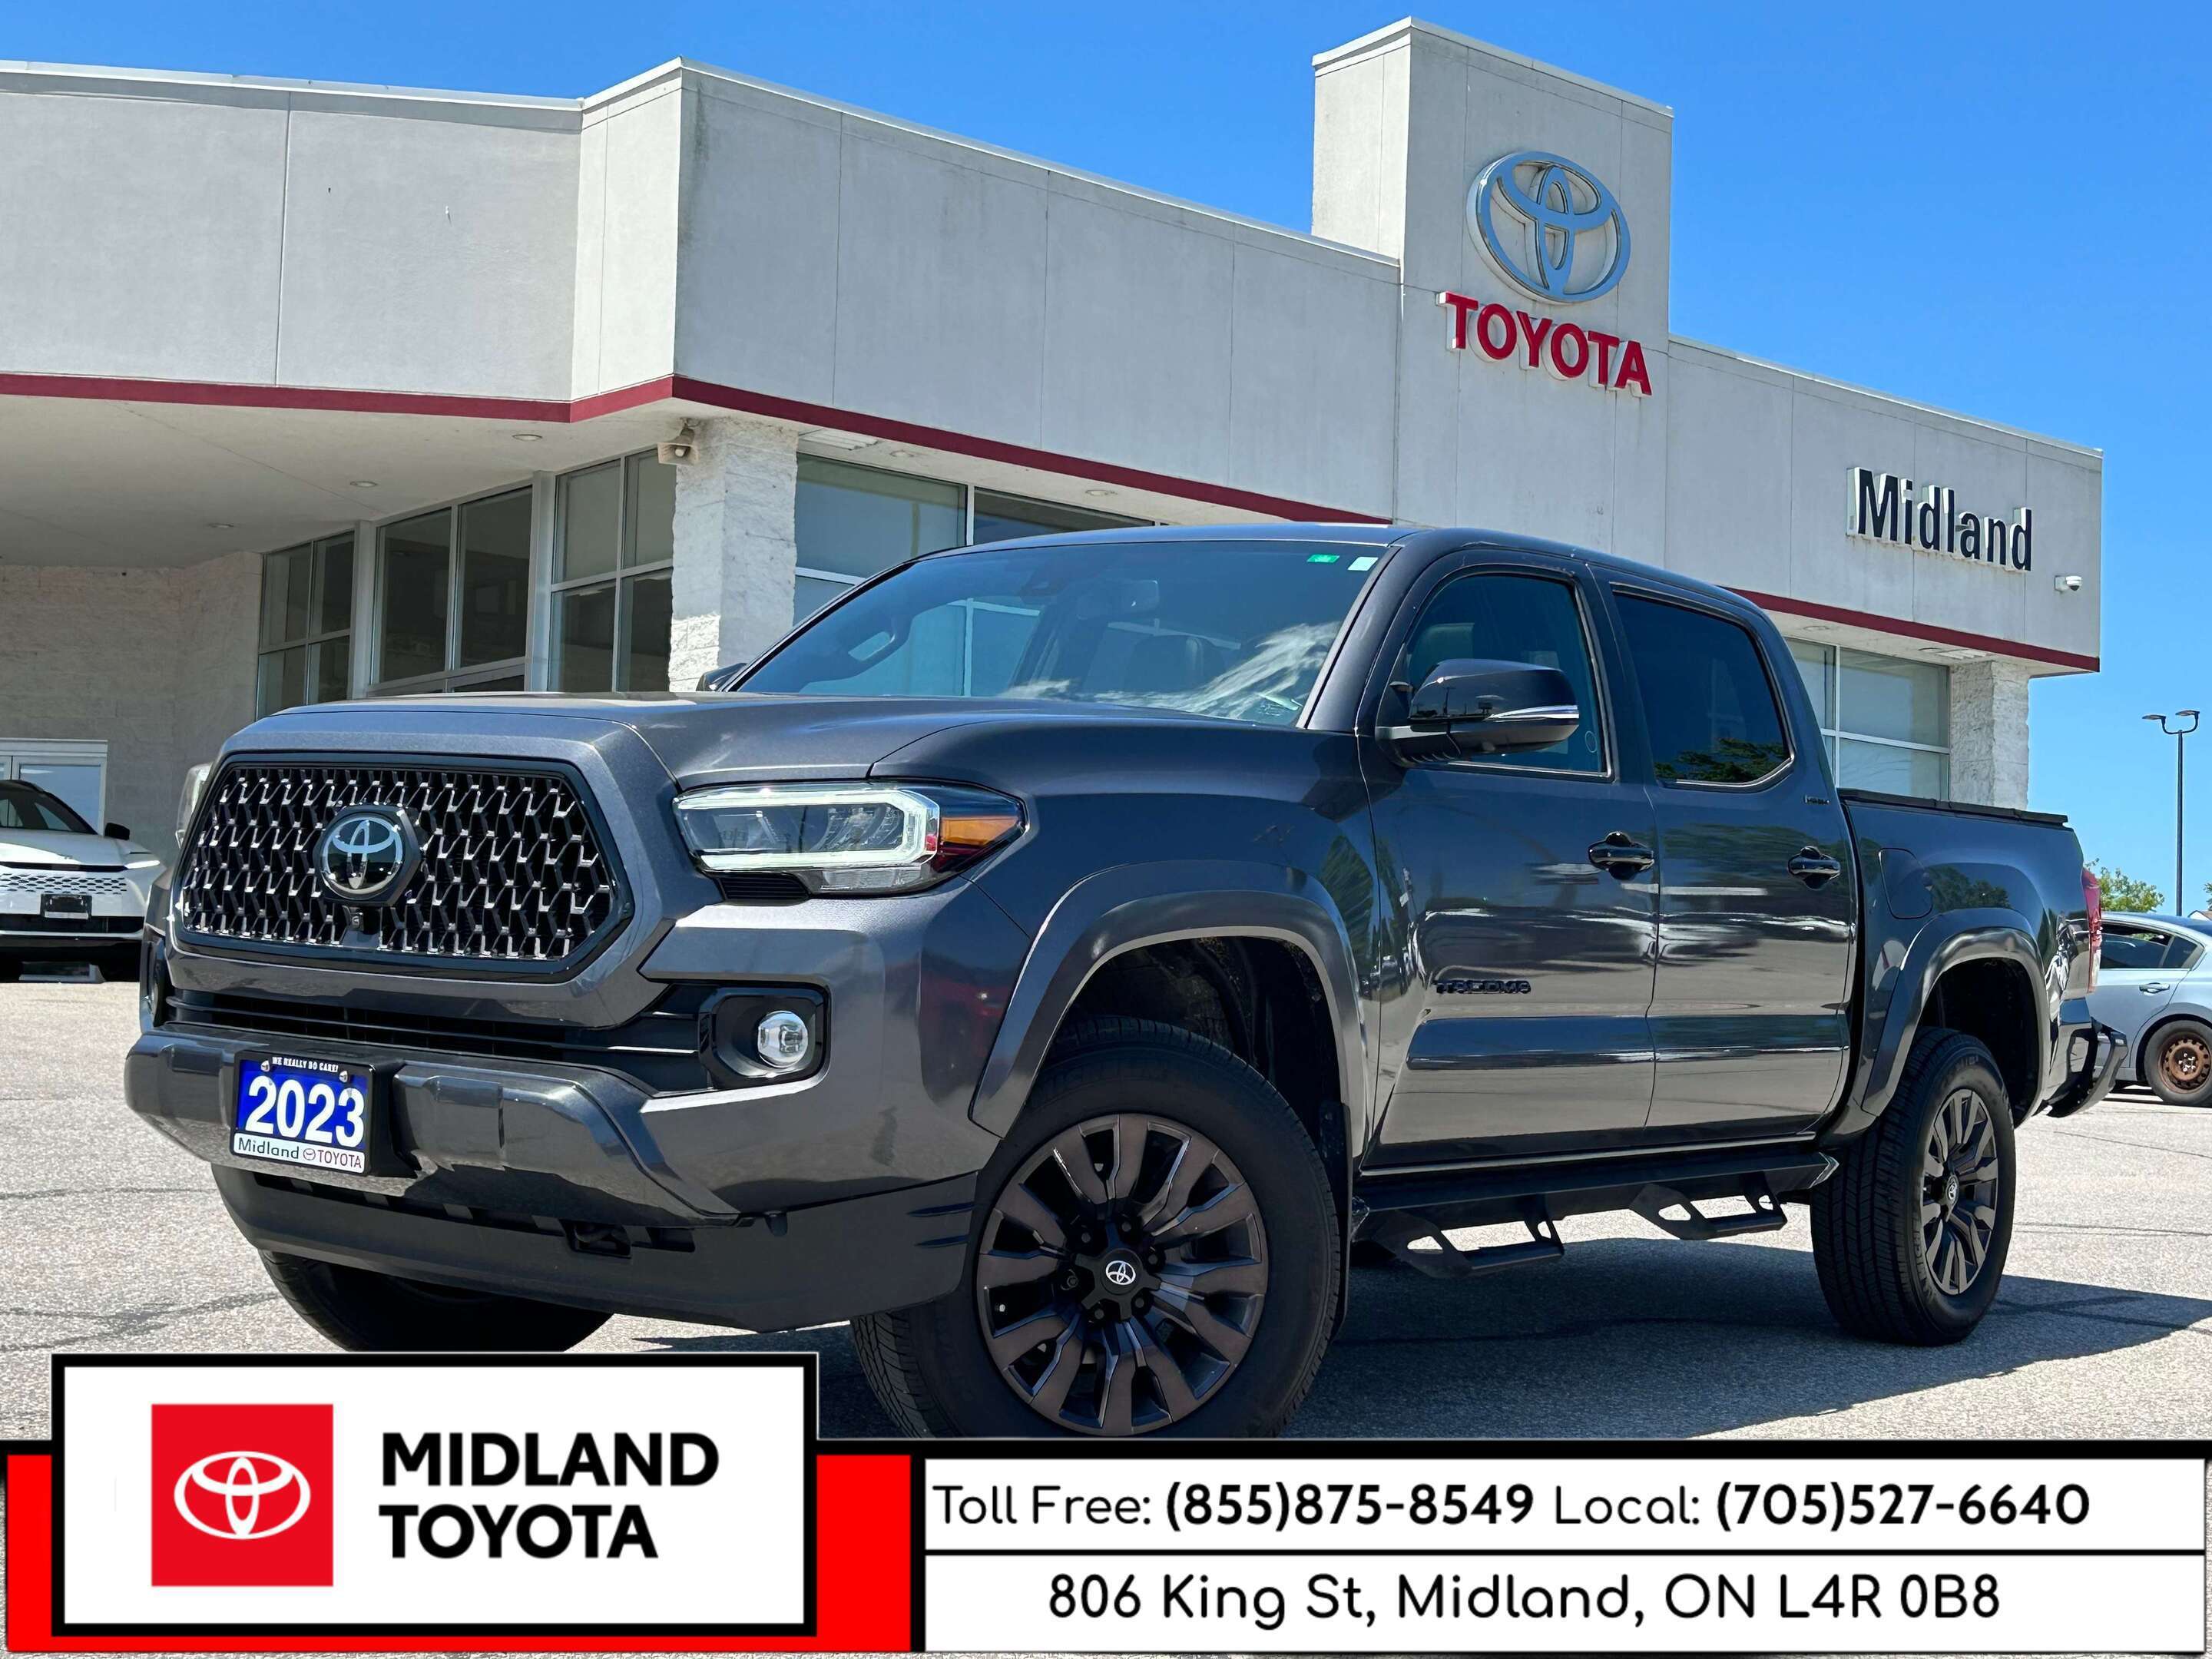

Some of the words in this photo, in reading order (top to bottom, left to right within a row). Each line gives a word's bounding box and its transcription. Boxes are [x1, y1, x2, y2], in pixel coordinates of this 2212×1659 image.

[1442, 290, 1652, 396] TOYOTA
[1853, 467, 2032, 571] Midland
[272, 1057, 283, 1065] WE
[283, 1058, 307, 1068] REALLY
[244, 1075, 365, 1147] 2023
[238, 1137, 300, 1159] Midland
[317, 1149, 363, 1169] TOYOTA
